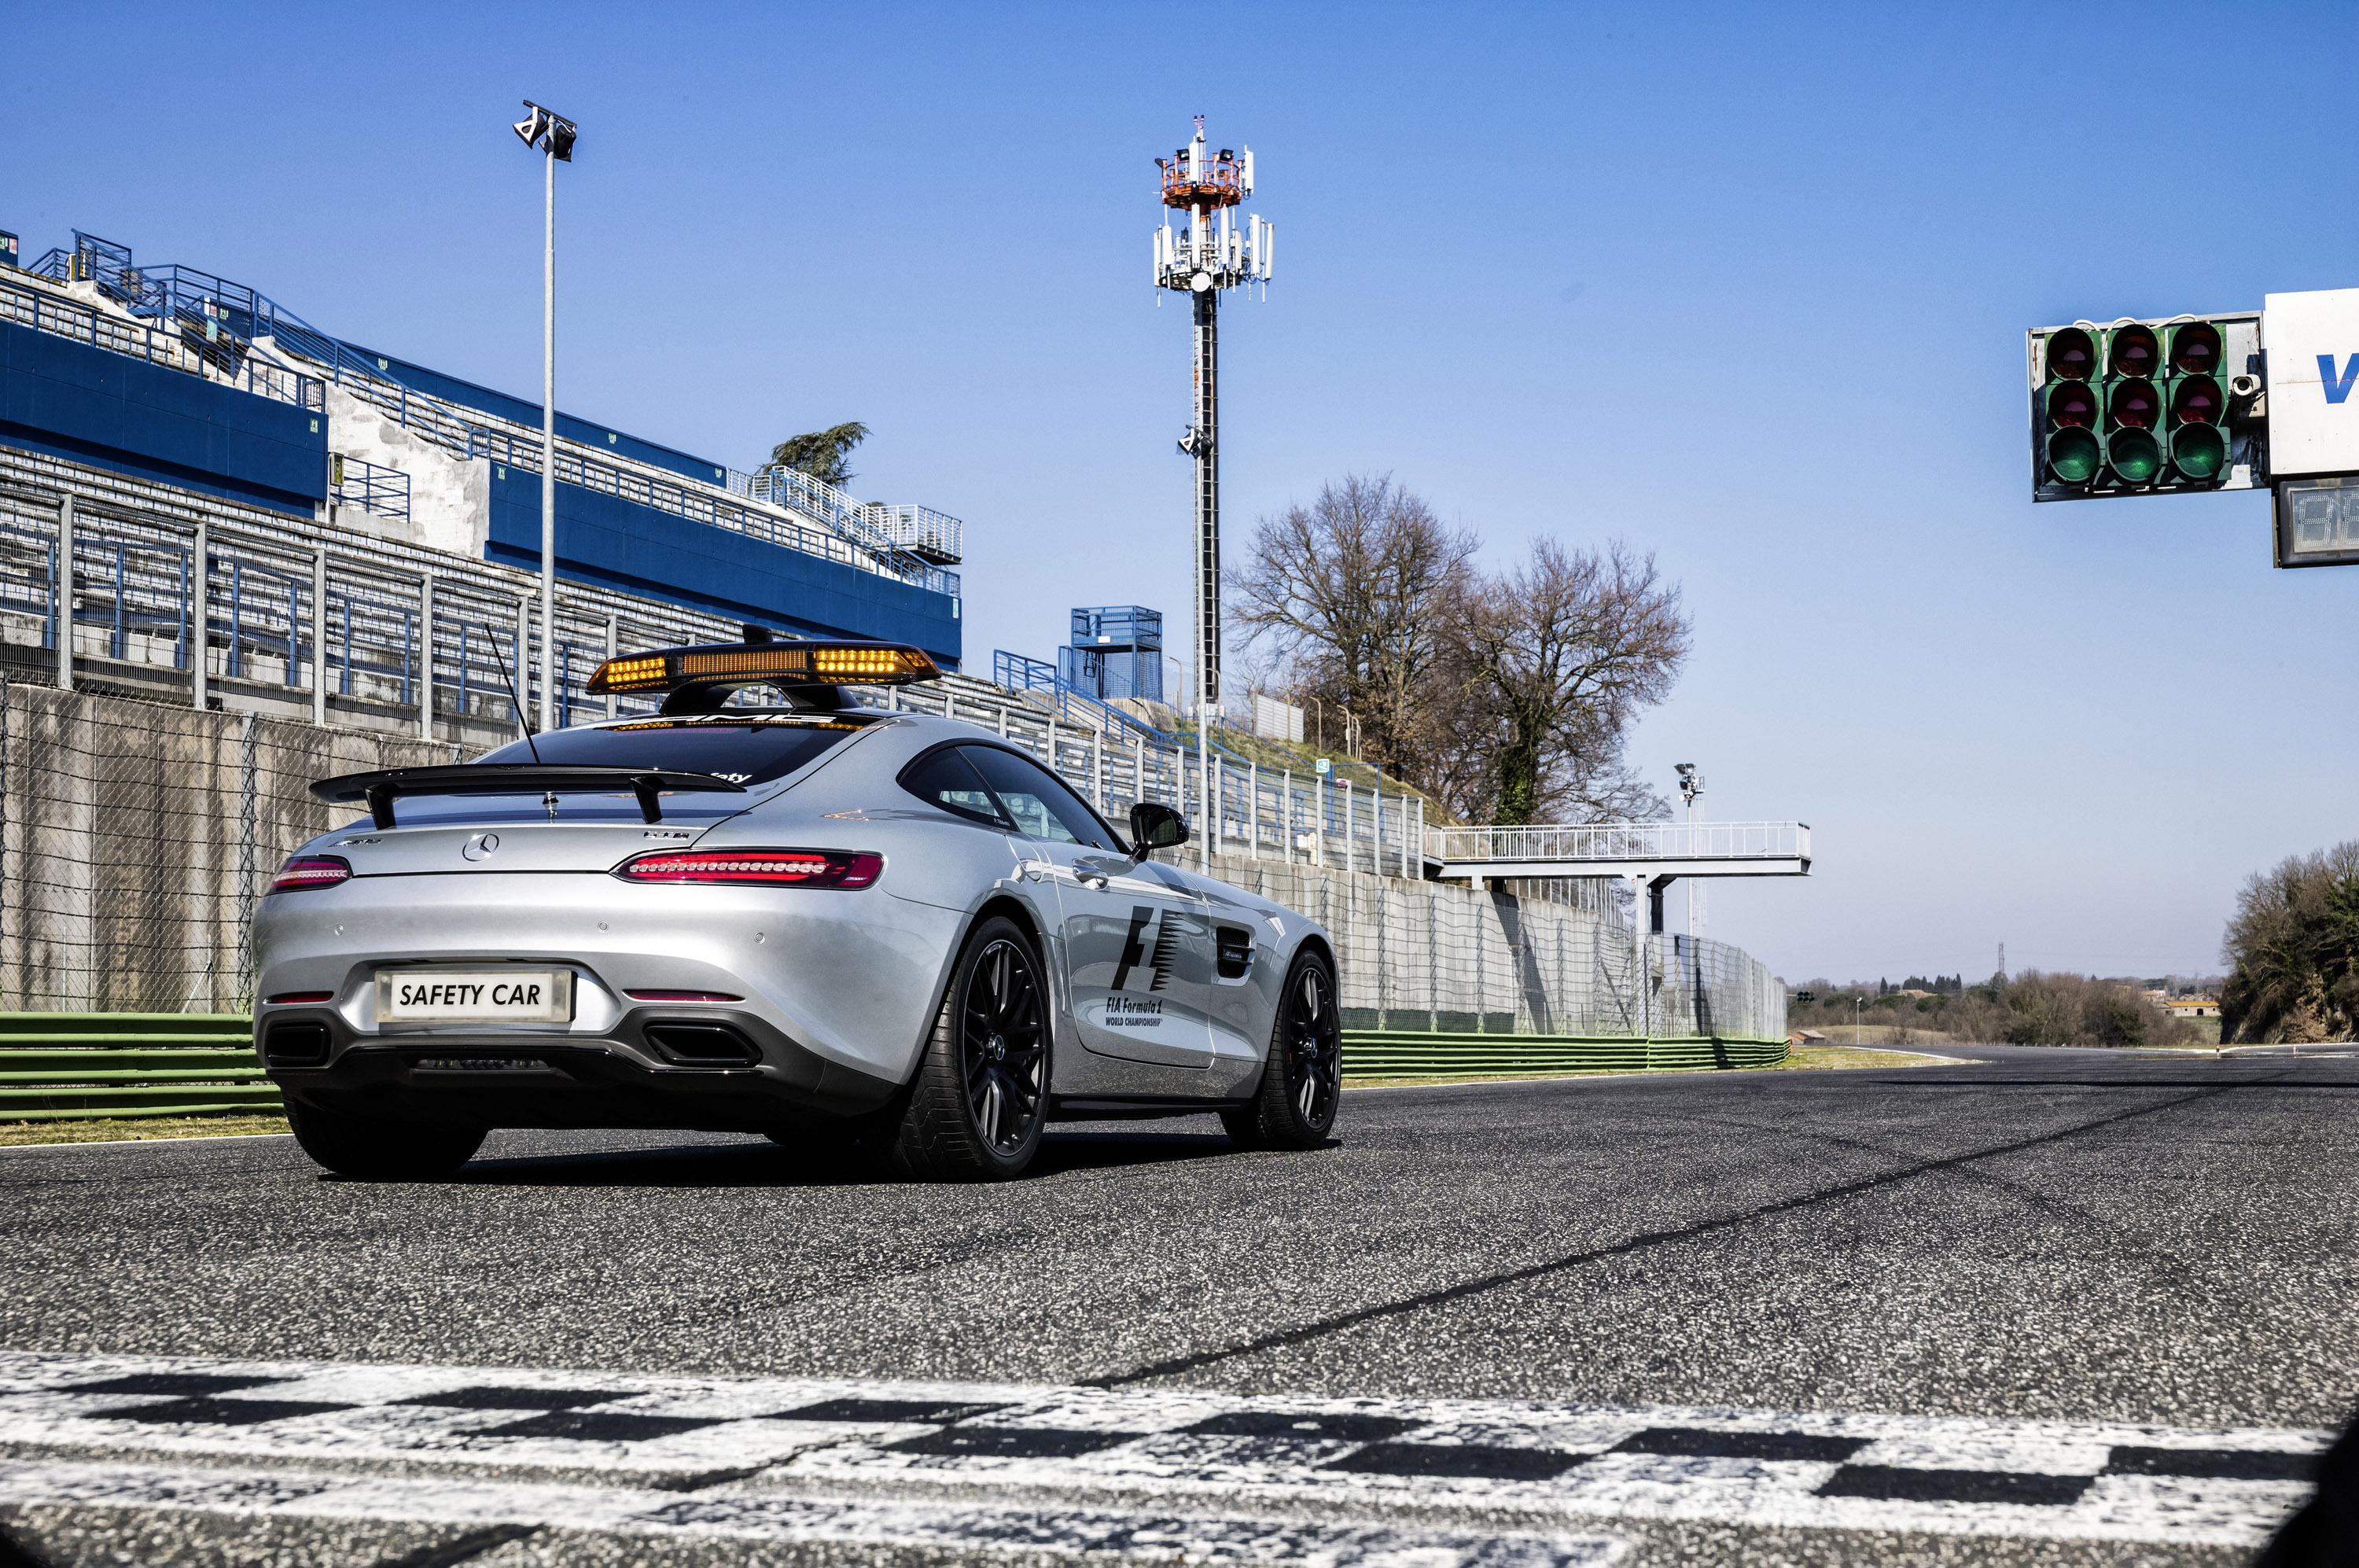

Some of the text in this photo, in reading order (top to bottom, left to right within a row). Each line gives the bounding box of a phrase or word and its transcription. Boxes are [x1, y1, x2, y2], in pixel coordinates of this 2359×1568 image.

[2316, 352, 2359, 404] V
[399, 984, 540, 1006] SAFETY CAR
[1106, 997, 1163, 1014] FIA Formula 1
[1106, 1017, 1124, 1026] WORLD
